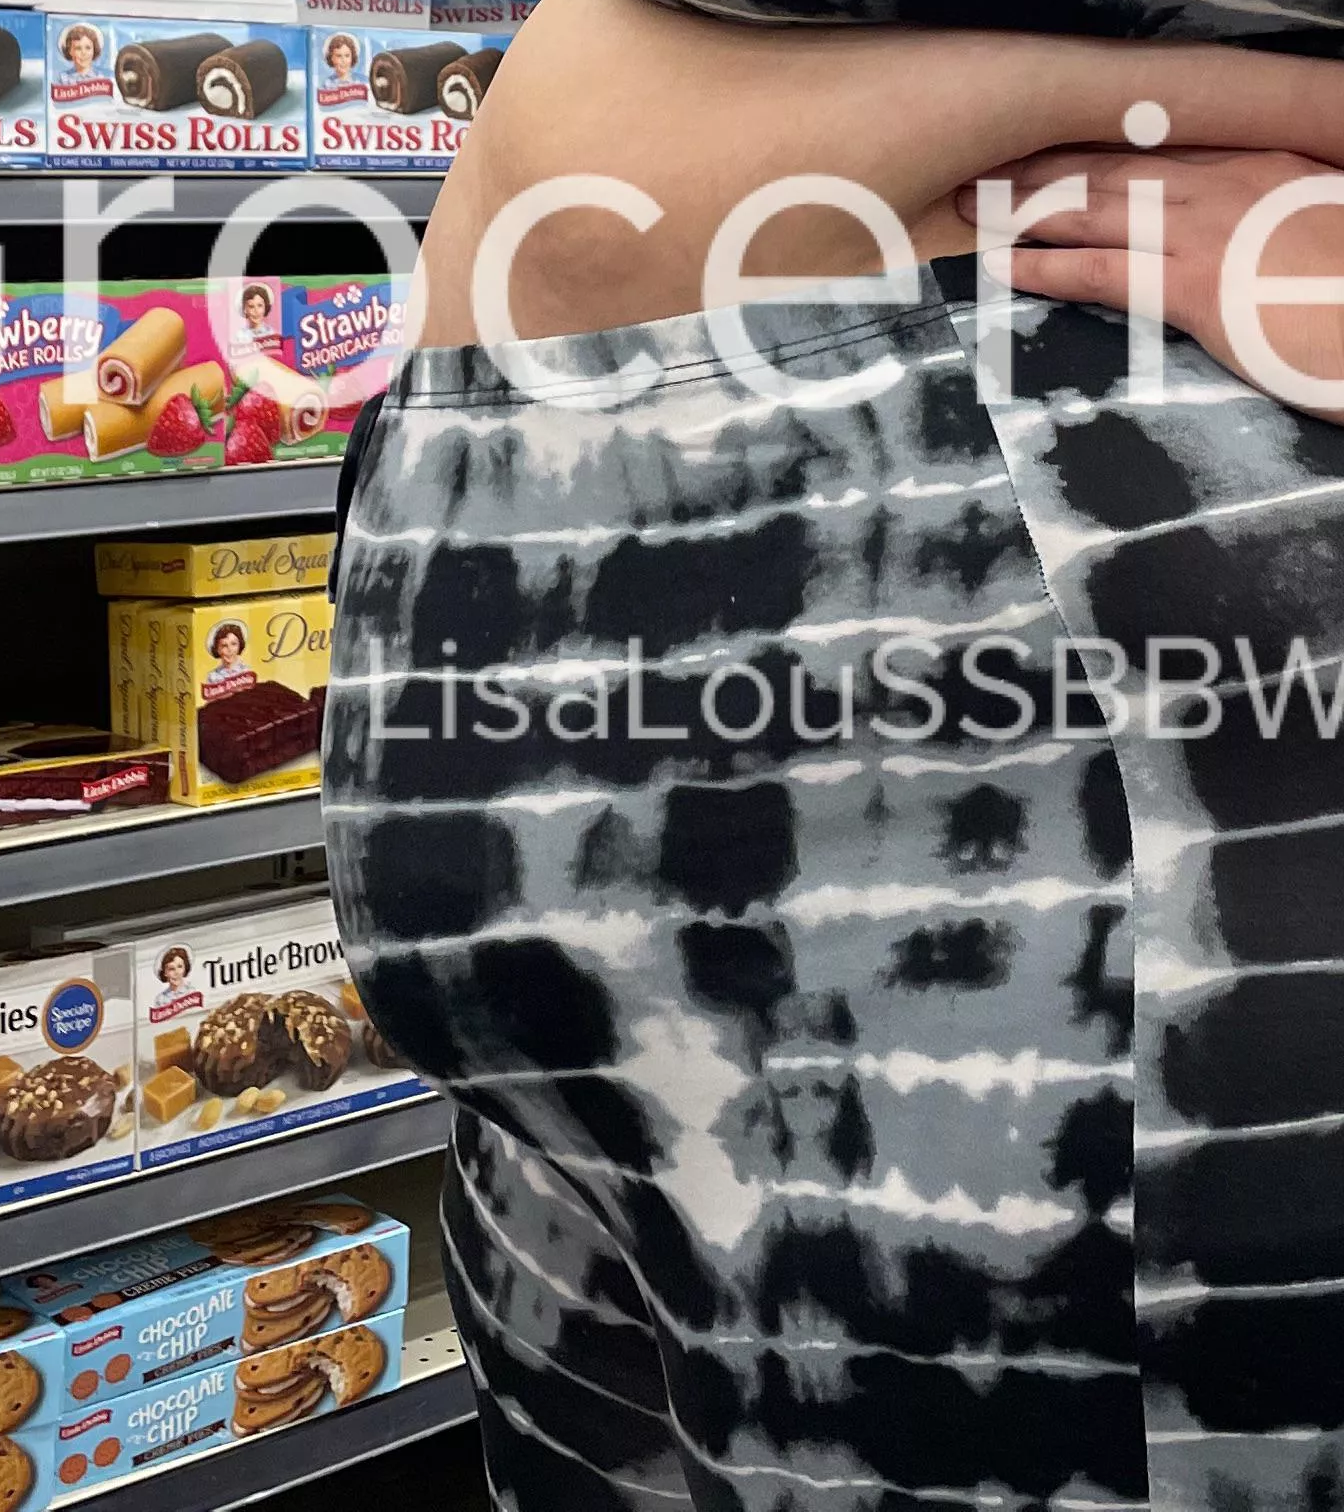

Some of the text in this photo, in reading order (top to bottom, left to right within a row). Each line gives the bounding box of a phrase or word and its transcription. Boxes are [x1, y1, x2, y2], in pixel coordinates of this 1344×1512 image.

[56, 115, 301, 153] SWISS ROLLS
[203, 947, 277, 988] Turtle
[50, 1002, 96, 1021] Specialty
[56, 1014, 92, 1035] Recipe
[123, 1261, 211, 1298] CREME PIES
[138, 1290, 235, 1344] CHOCOLATE
[157, 1324, 207, 1361] CHIP
[128, 1372, 225, 1428] CHOCOLATE
[147, 1406, 198, 1445] CHIP
